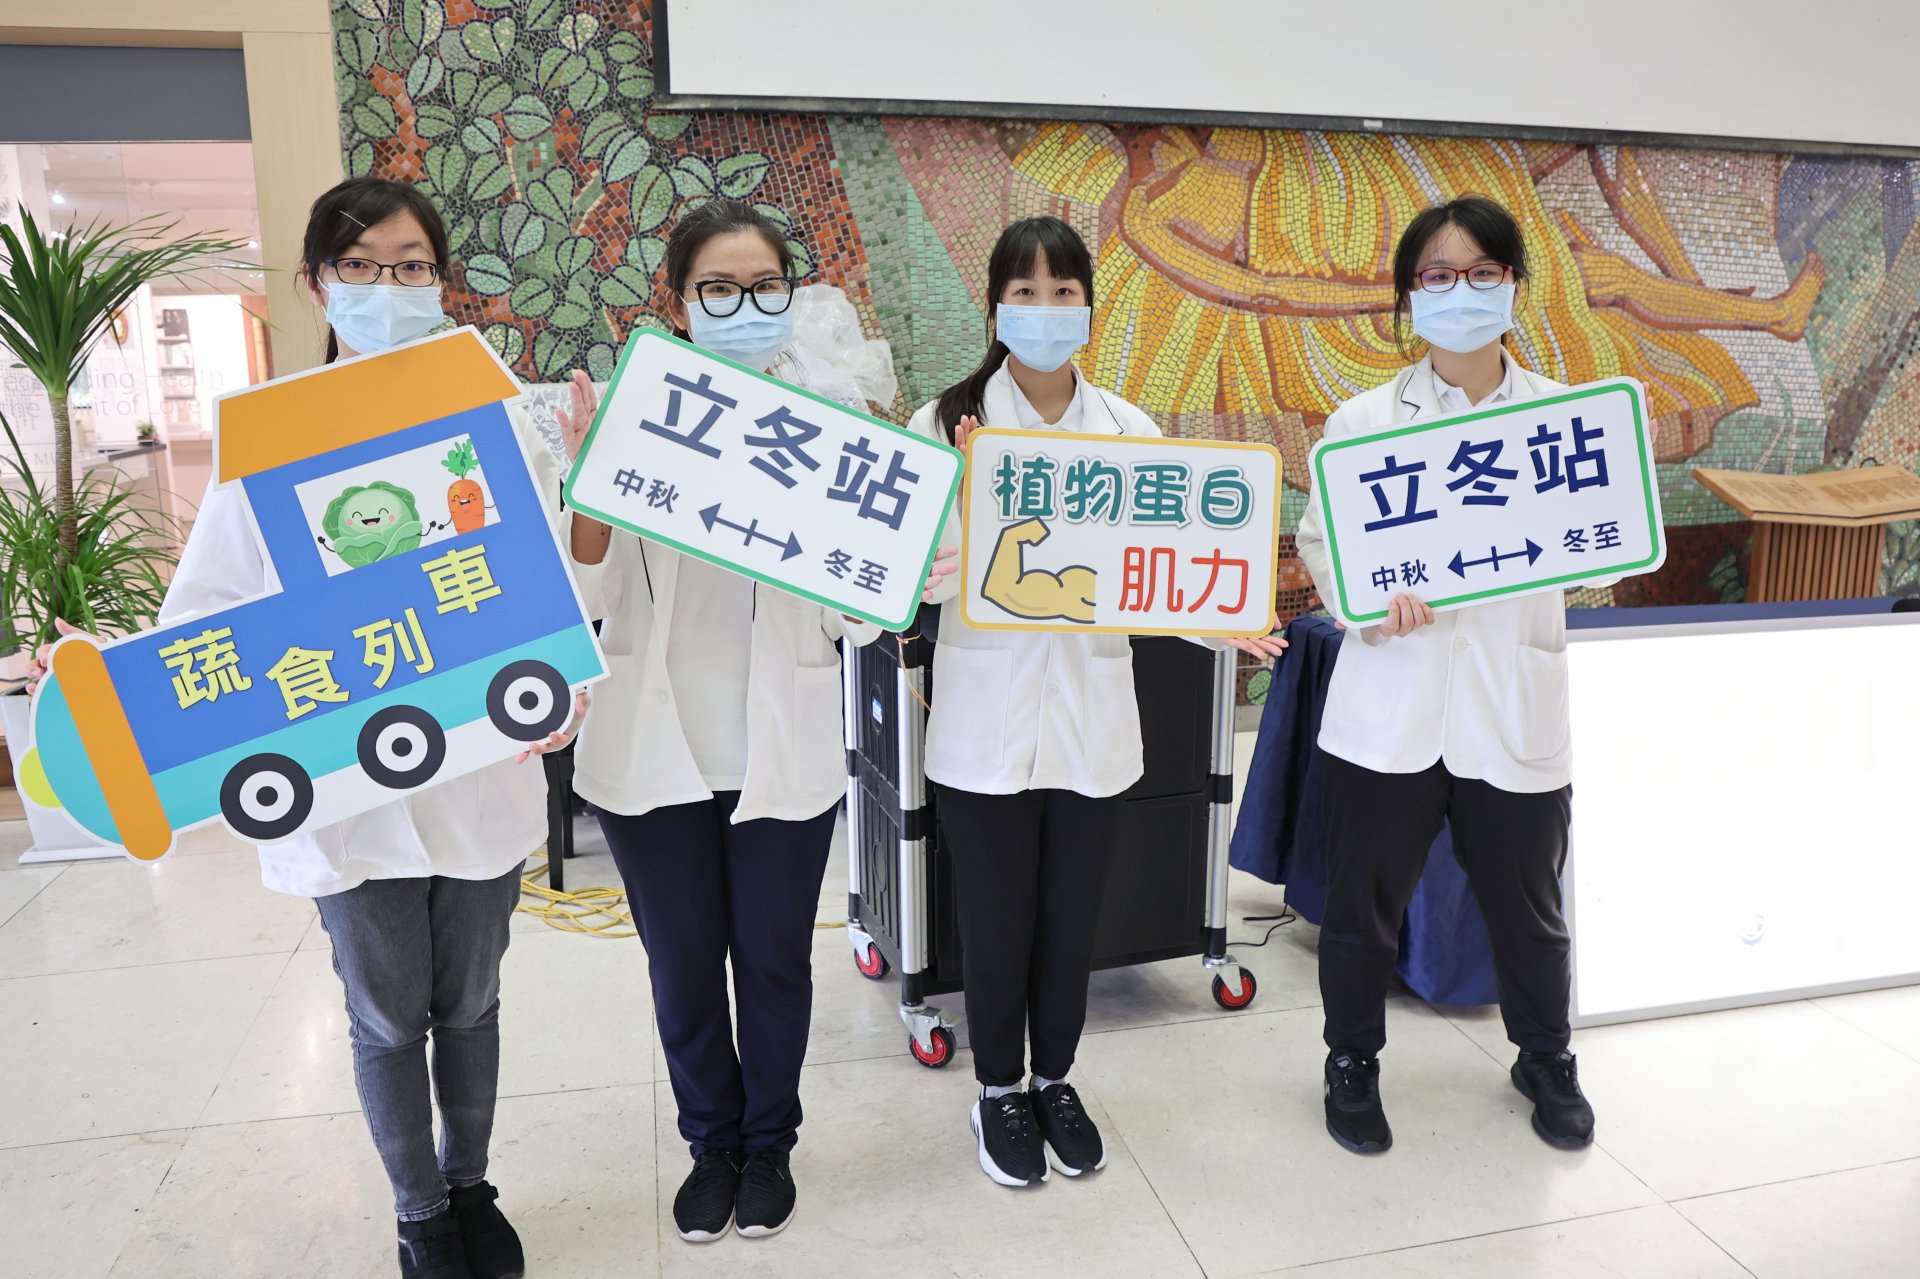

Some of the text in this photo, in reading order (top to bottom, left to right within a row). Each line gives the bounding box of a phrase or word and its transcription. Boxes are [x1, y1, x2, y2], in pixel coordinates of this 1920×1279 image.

[638, 372, 921, 531] 立冬站
[992, 452, 1252, 528] 植物蛋白
[1358, 416, 1610, 533] 立冬站
[612, 468, 889, 595] 中秋 冬至
[1118, 546, 1249, 614] 肌力
[1371, 520, 1622, 592] 中秋 冬至
[158, 544, 503, 721] 蔬食列車
